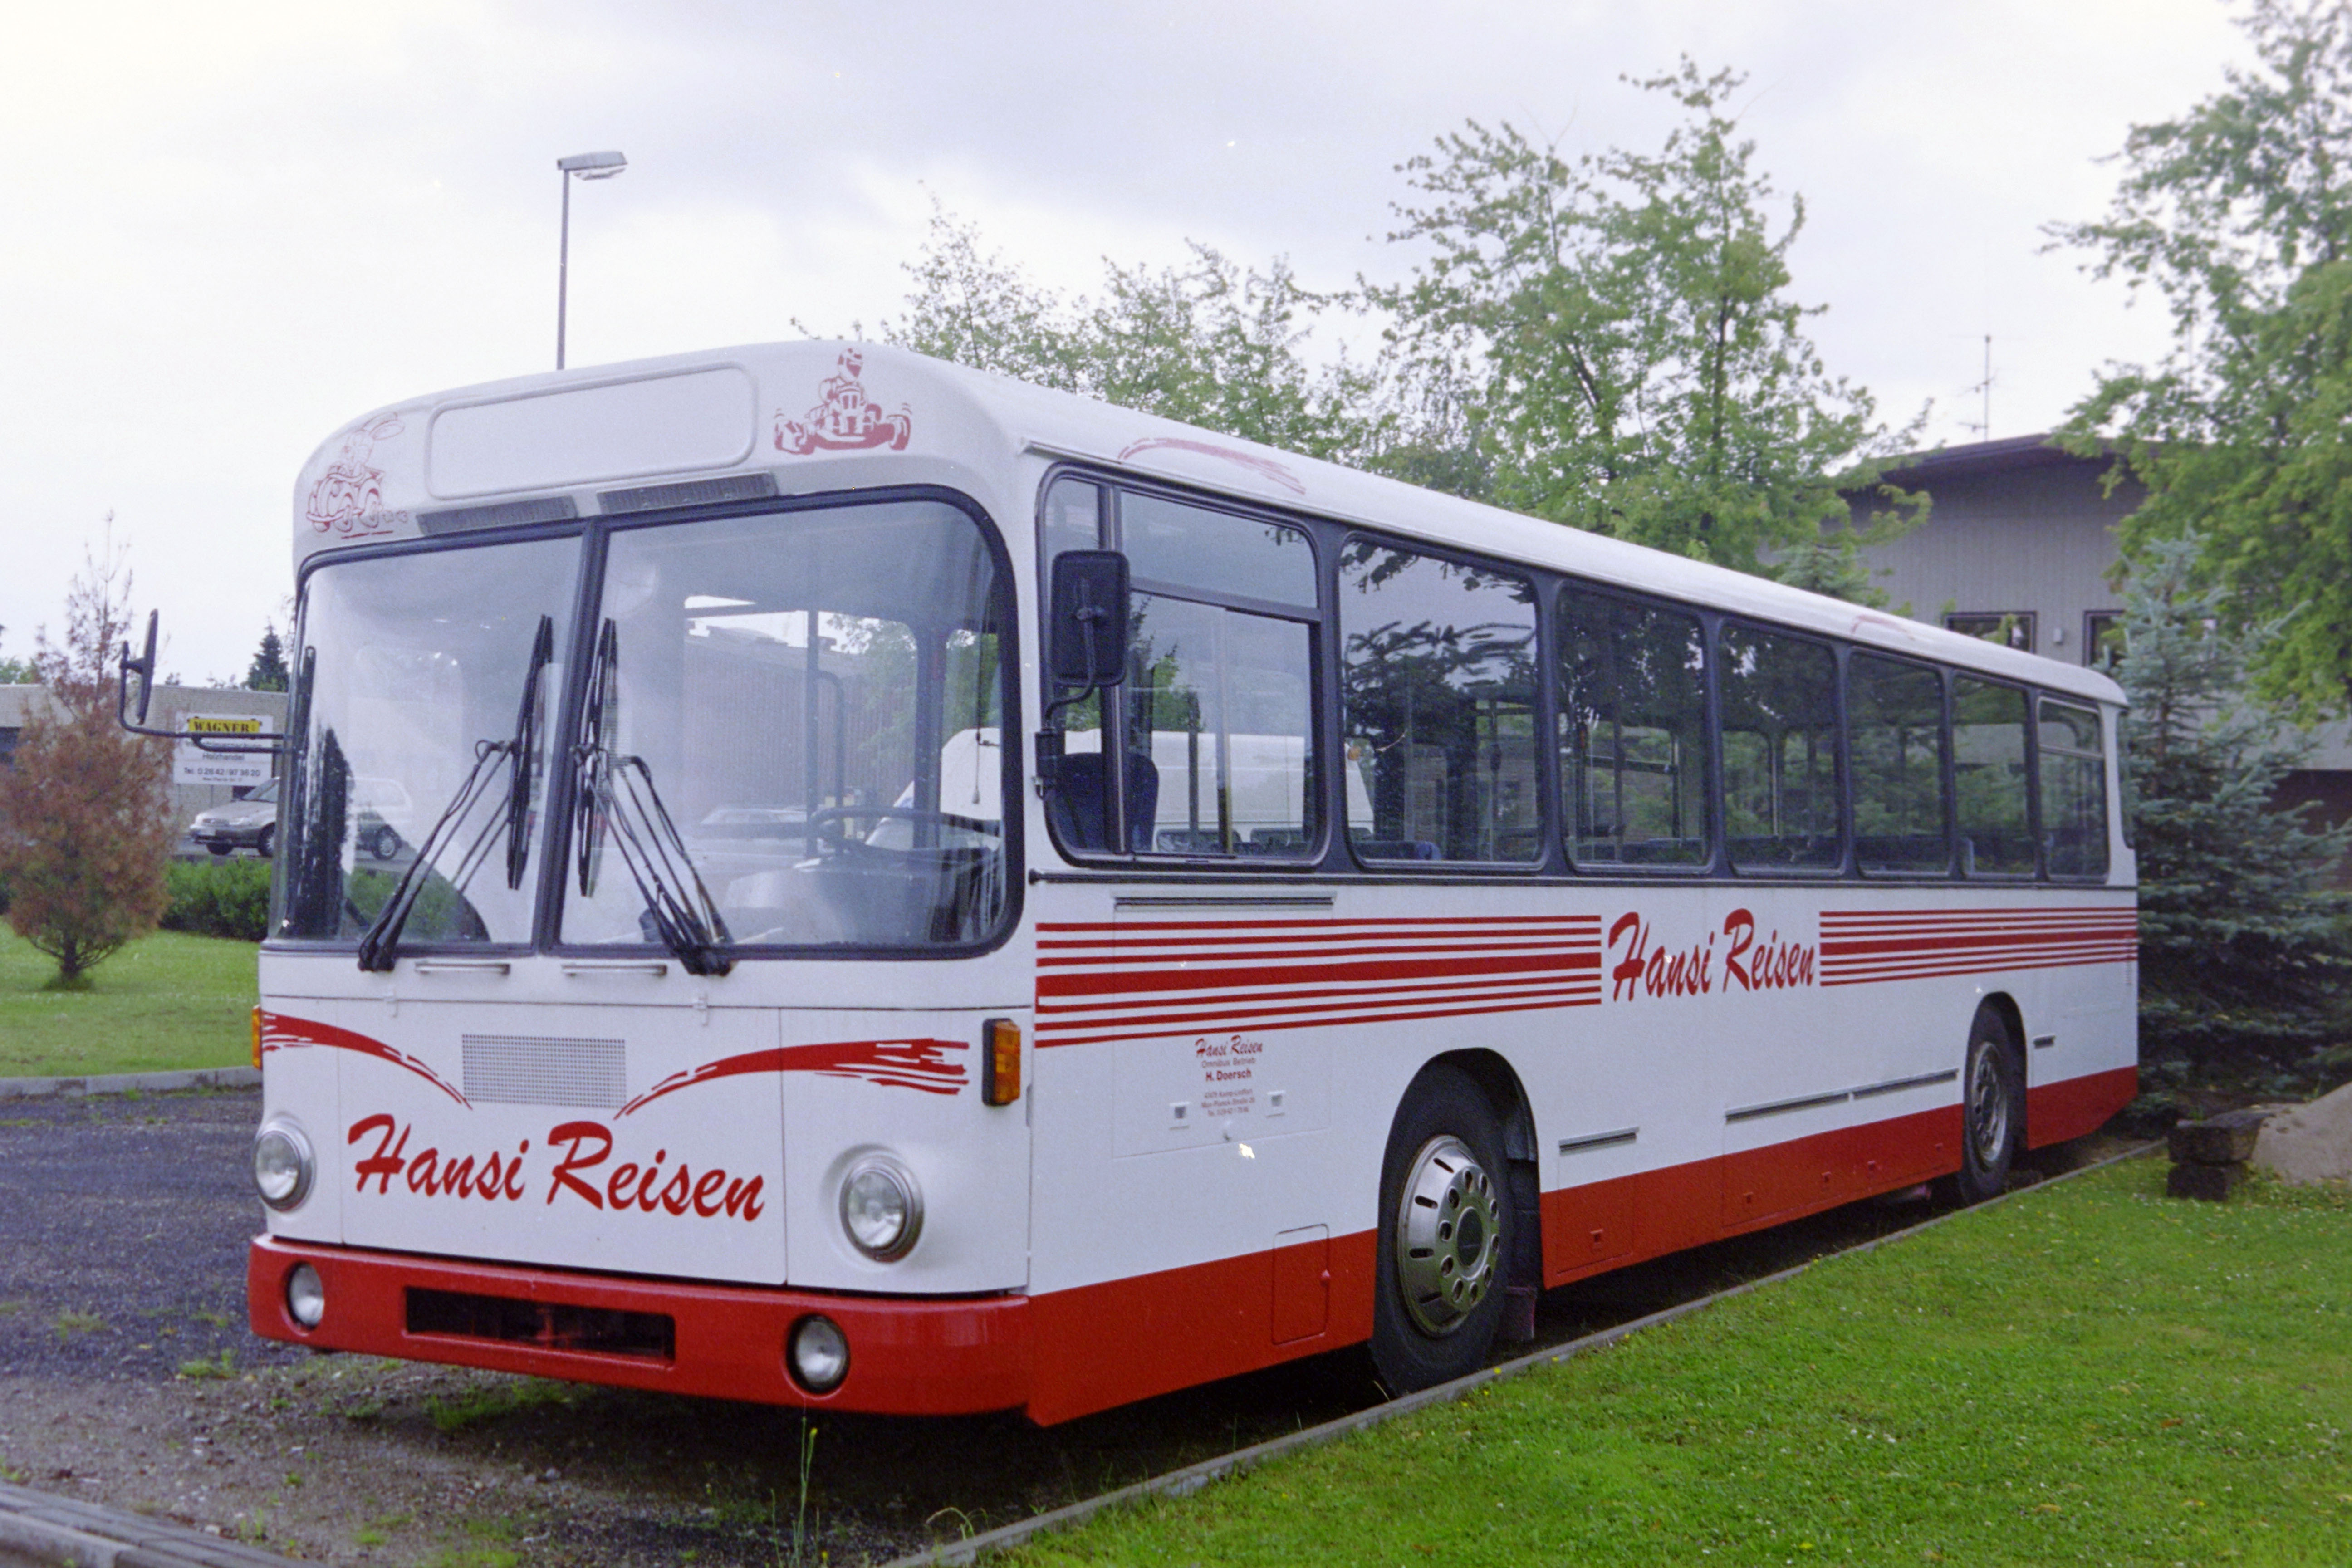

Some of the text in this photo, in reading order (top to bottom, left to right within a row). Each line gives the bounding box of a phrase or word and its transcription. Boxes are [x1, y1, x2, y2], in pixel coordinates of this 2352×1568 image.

[194, 721, 250, 732] WAGNER
[1609, 908, 1814, 1001] Hansi Reisen
[1195, 1034, 1263, 1058] Hansi Reisen
[1206, 1068, 1252, 1081] H. Doersch
[348, 1114, 765, 1222] Hansi Reisen
